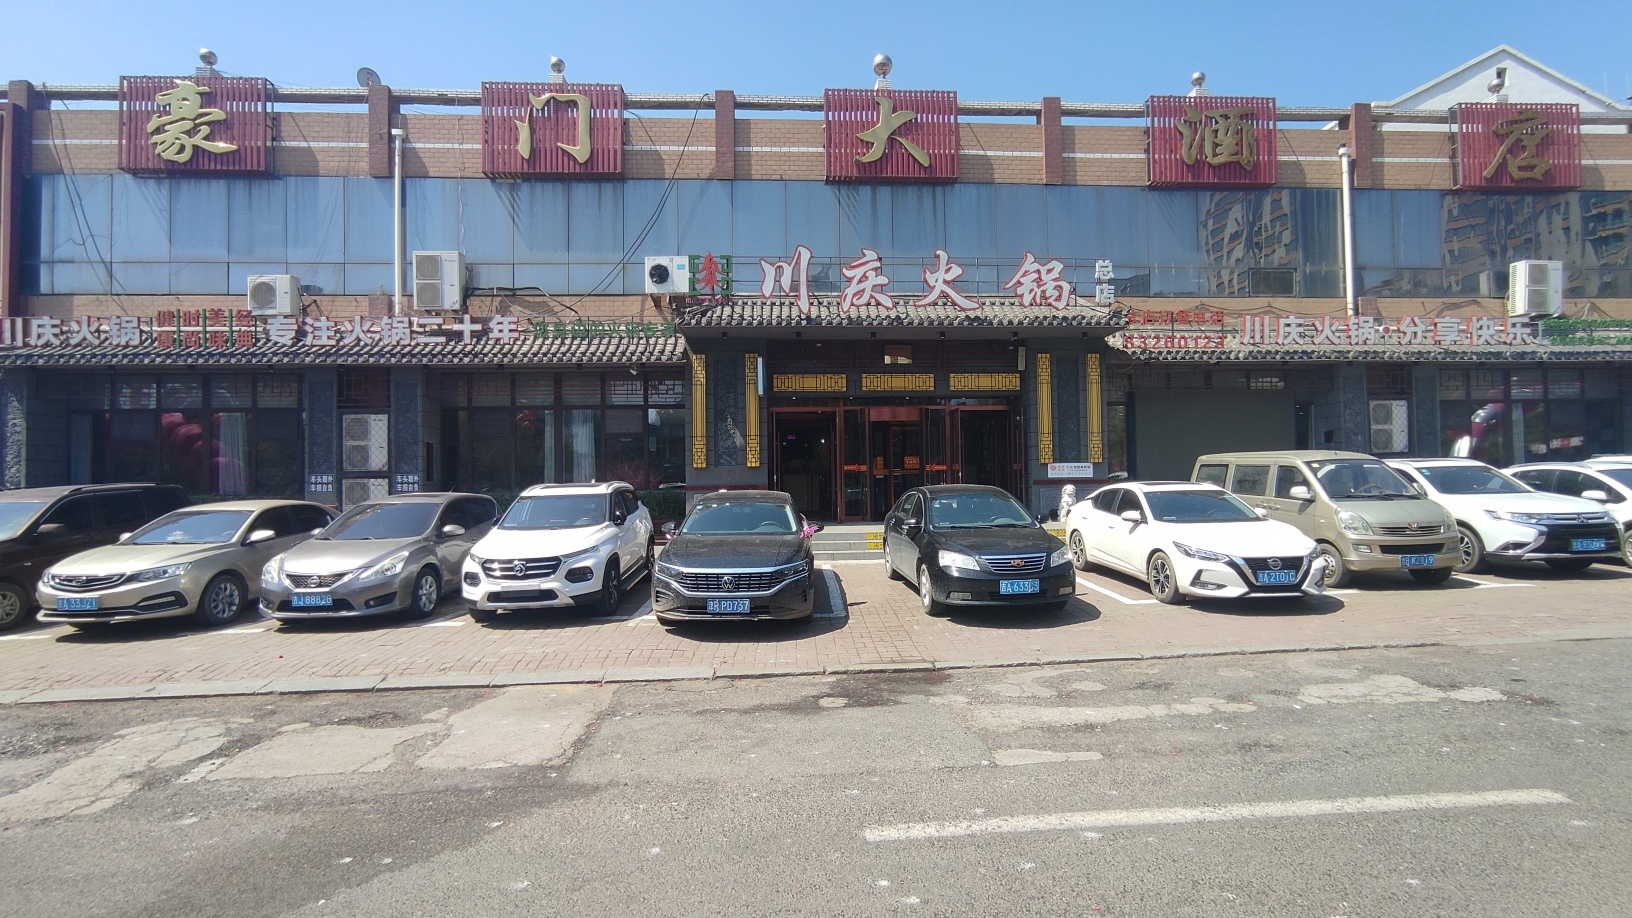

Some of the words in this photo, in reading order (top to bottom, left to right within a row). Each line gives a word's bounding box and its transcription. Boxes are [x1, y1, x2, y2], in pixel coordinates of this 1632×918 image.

[146, 79, 239, 164] 豪
[514, 92, 592, 165] 门
[853, 96, 931, 168] 大
[1175, 101, 1256, 171] 酒
[1483, 110, 1552, 181] 店
[759, 245, 1072, 316] 川庆火锅
[1095, 259, 1115, 304] 总店
[266, 314, 520, 347] 专注火锅二十年
[1124, 334, 1226, 350] 83260123
